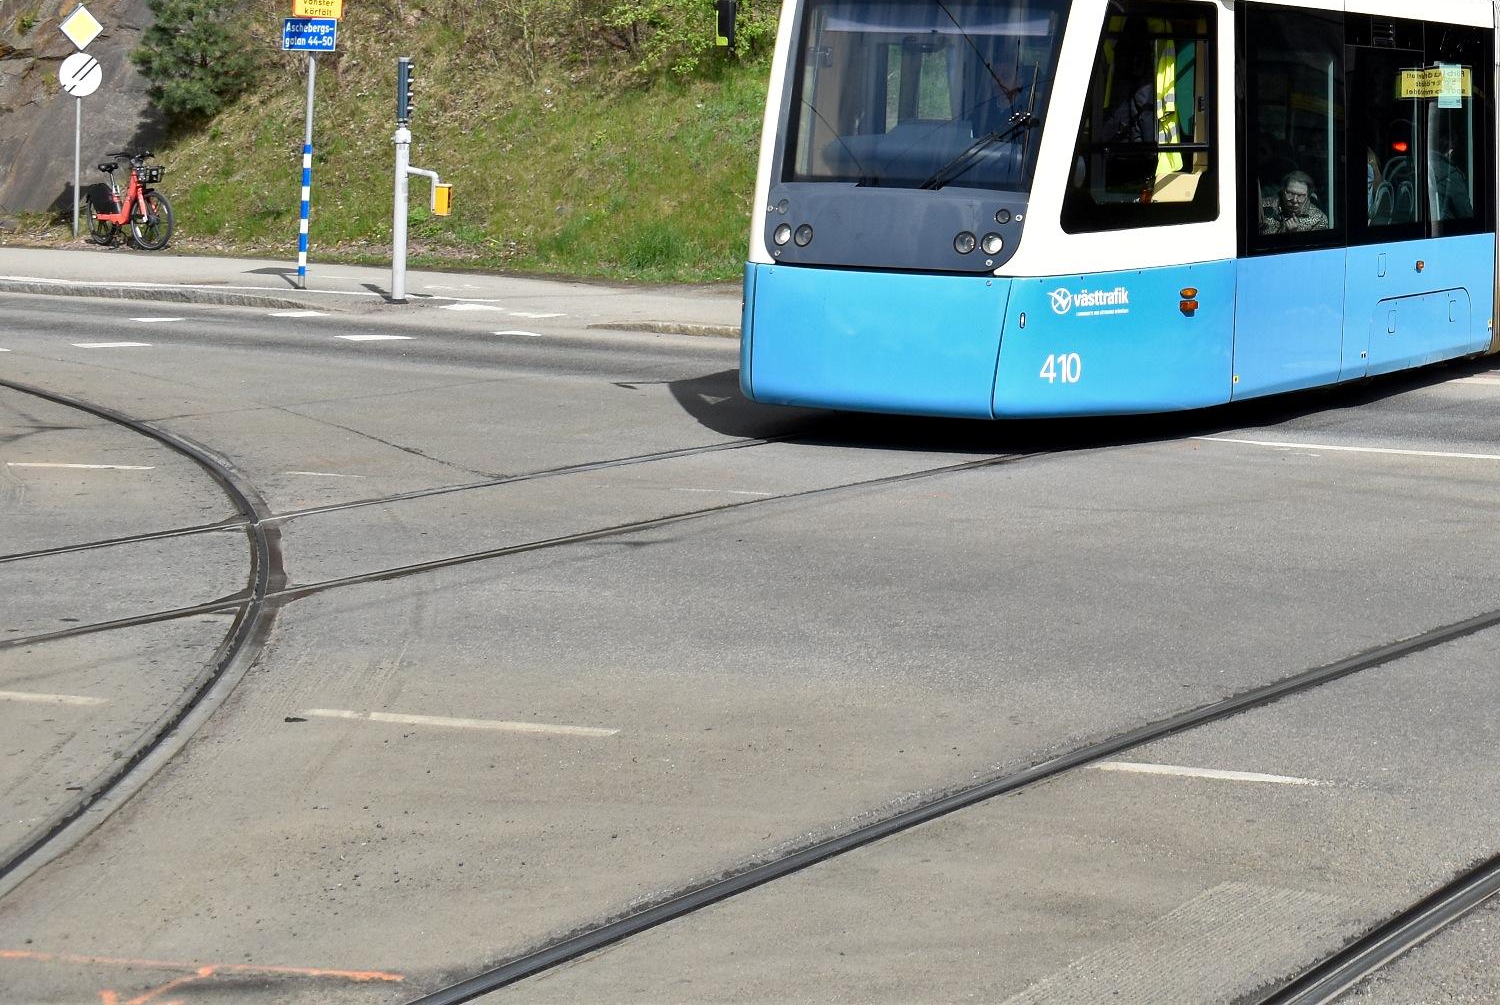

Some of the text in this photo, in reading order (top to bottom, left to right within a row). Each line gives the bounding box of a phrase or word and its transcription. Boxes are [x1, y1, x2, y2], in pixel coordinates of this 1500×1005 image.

[304, 7, 332, 16] körfält
[285, 21, 334, 35] Aschebergs-
[285, 35, 333, 47] gatan 44-50
[1073, 287, 1129, 307] västtrafik
[1040, 352, 1081, 383] 410
